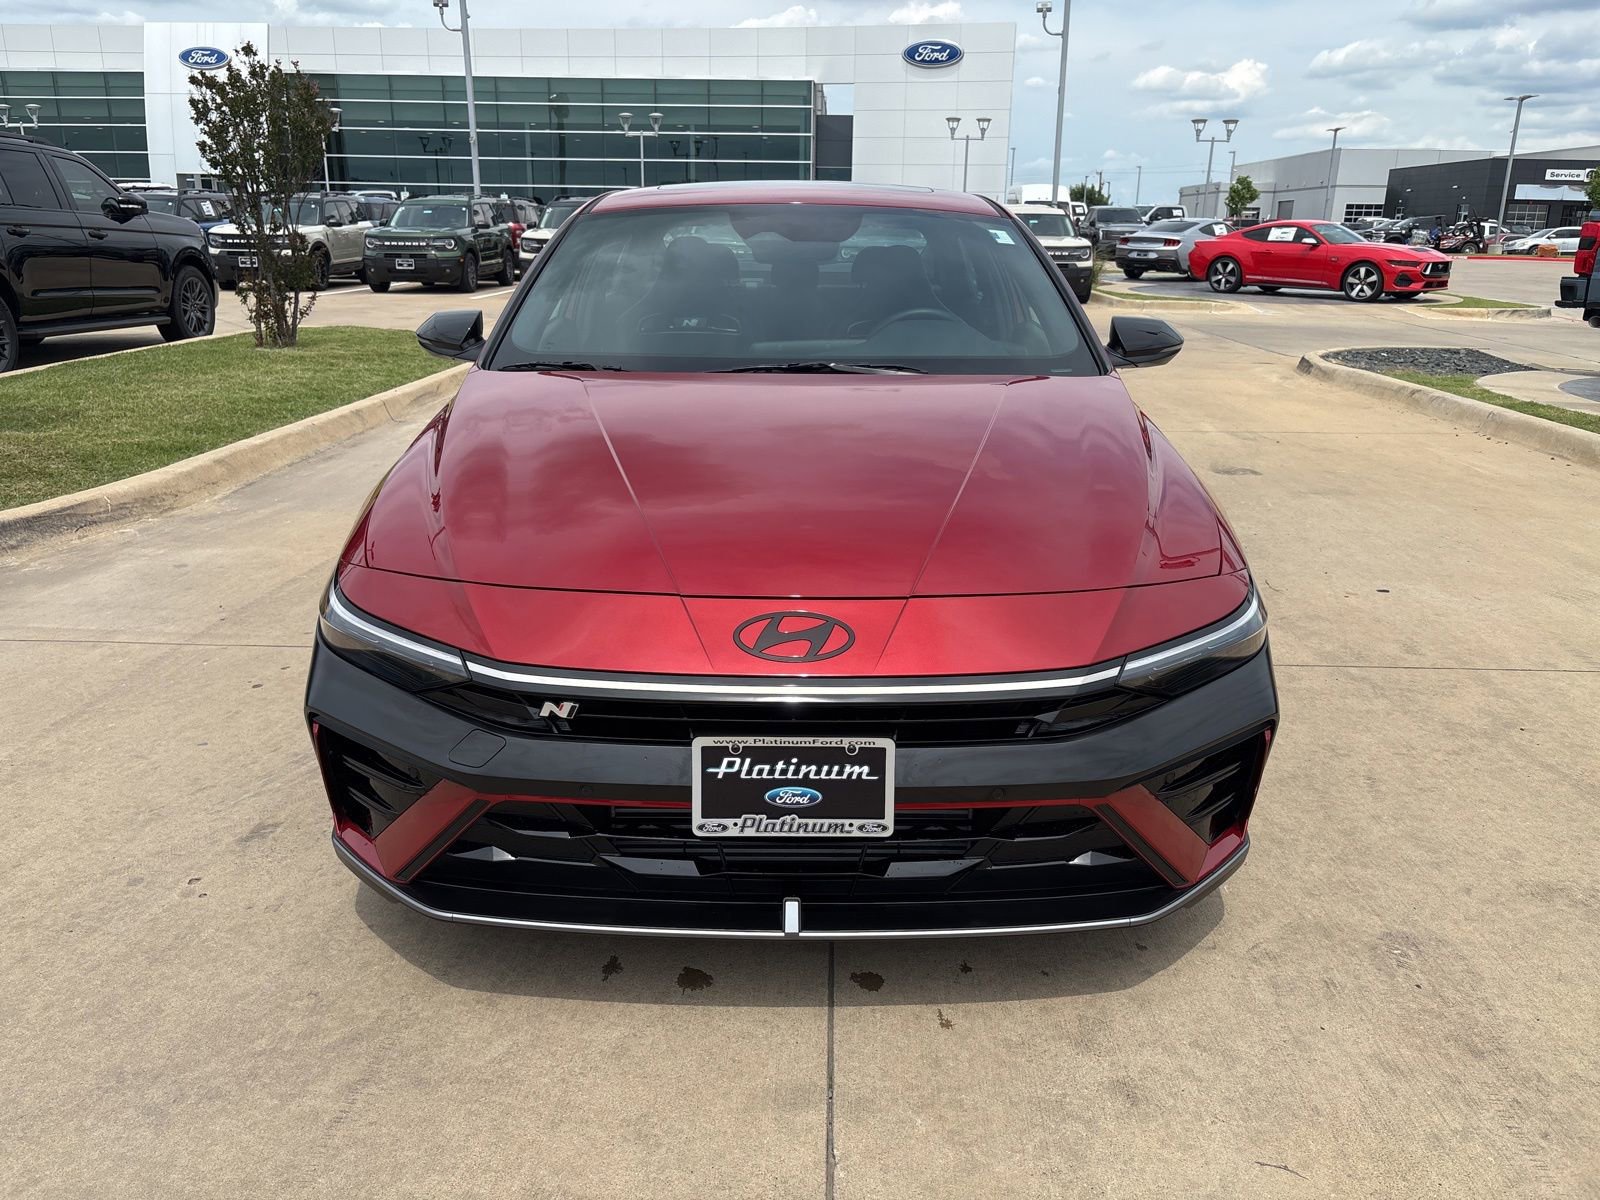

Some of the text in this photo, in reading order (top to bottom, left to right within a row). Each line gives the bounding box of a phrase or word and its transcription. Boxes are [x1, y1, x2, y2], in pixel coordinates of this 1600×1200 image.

[188, 50, 218, 63] Ford
[914, 44, 950, 61] Ford
[1550, 171, 1581, 179] Service
[713, 738, 876, 746] www.PlatinumFord.com
[706, 757, 879, 779] Platinum
[775, 789, 811, 804] Ford
[702, 823, 723, 832] Ford
[739, 815, 854, 834] Platinum
[862, 823, 884, 832] Ford
